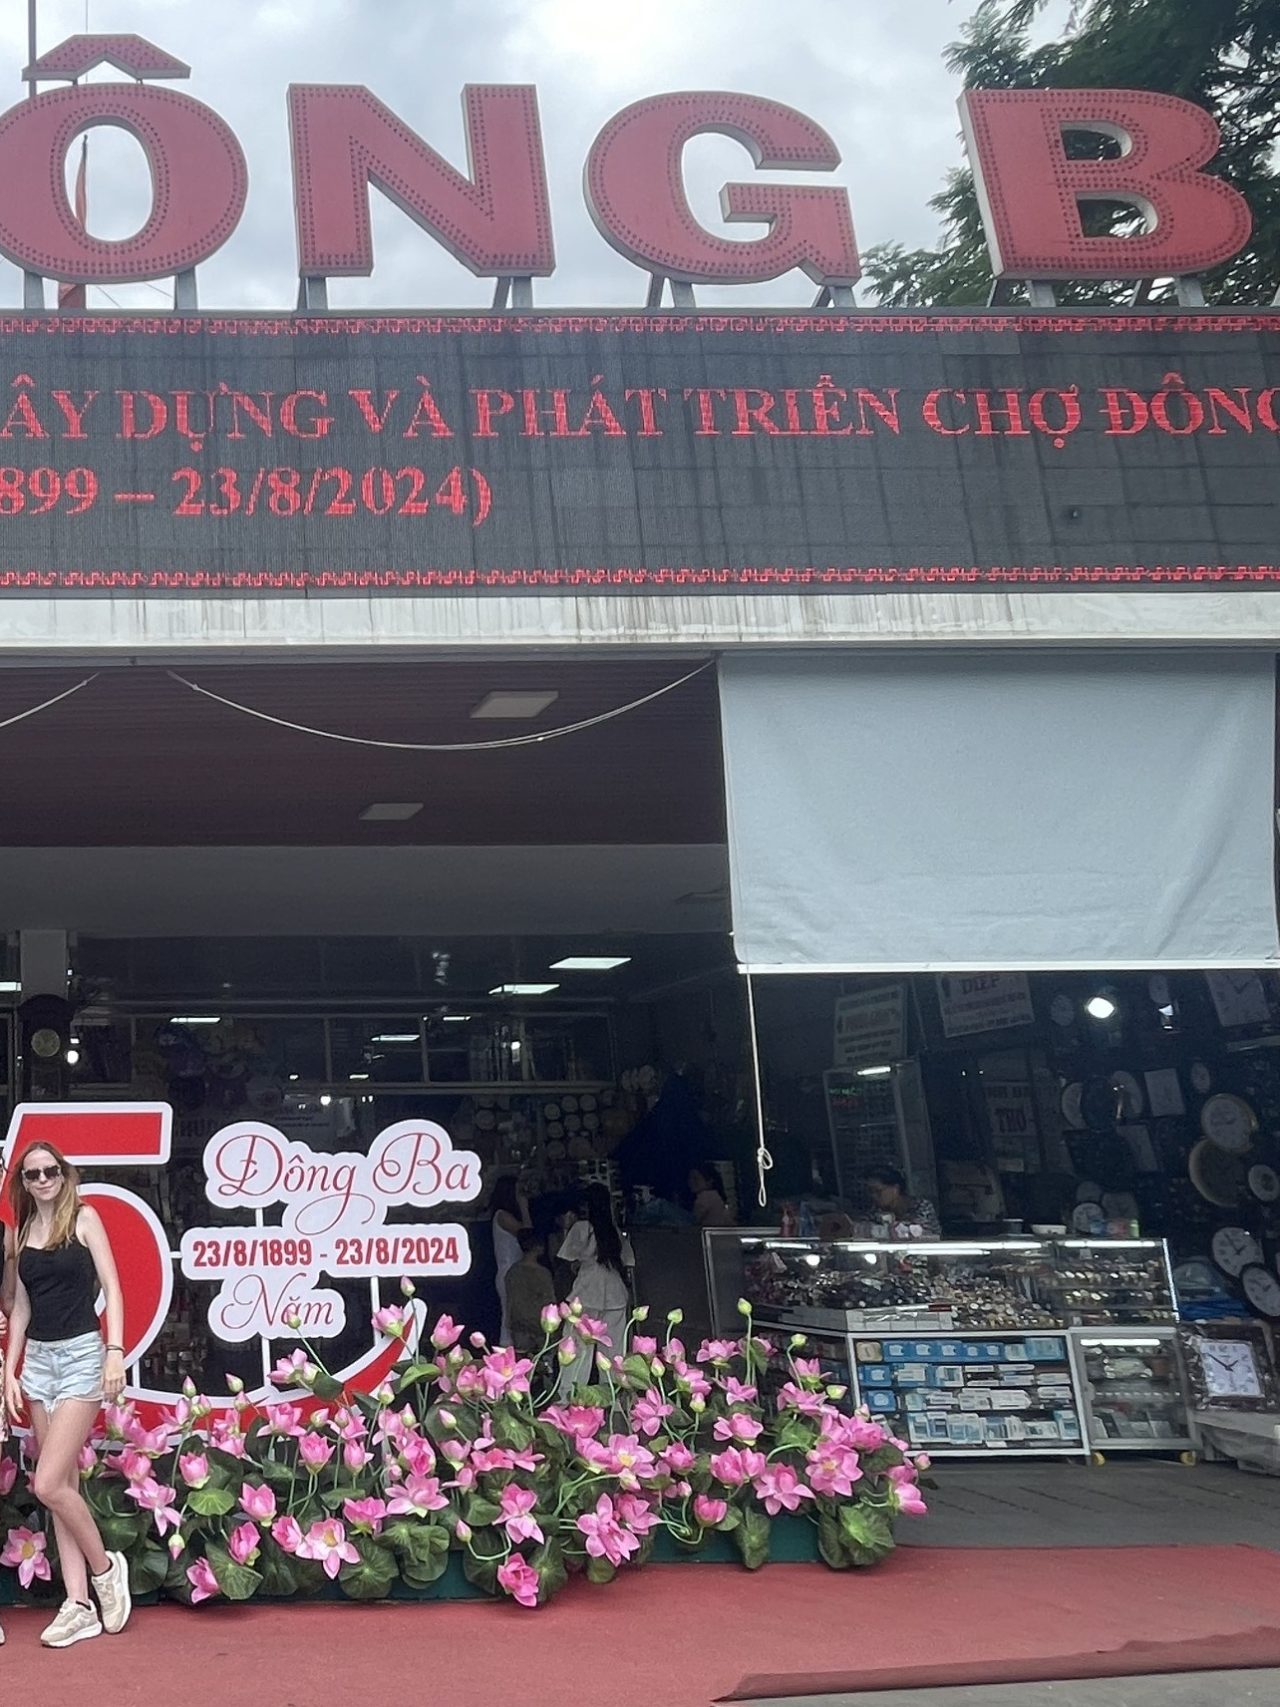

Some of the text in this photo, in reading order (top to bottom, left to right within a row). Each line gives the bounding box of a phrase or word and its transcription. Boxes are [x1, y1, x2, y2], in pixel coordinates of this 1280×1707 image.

[957, 88, 1253, 282] B
[115, 380, 335, 452] DỰNG
[349, 376, 454, 439] VÀ
[472, 374, 669, 438] PHÁT
[922, 383, 1082, 449] CHỢ
[173, 466, 492, 526] 23/8/2024)
[215, 1132, 471, 1236] Đông Ba
[192, 1237, 313, 1268] 23/8/1899
[334, 1236, 460, 1266] 23/8/2024
[220, 1271, 334, 1330] Năm
